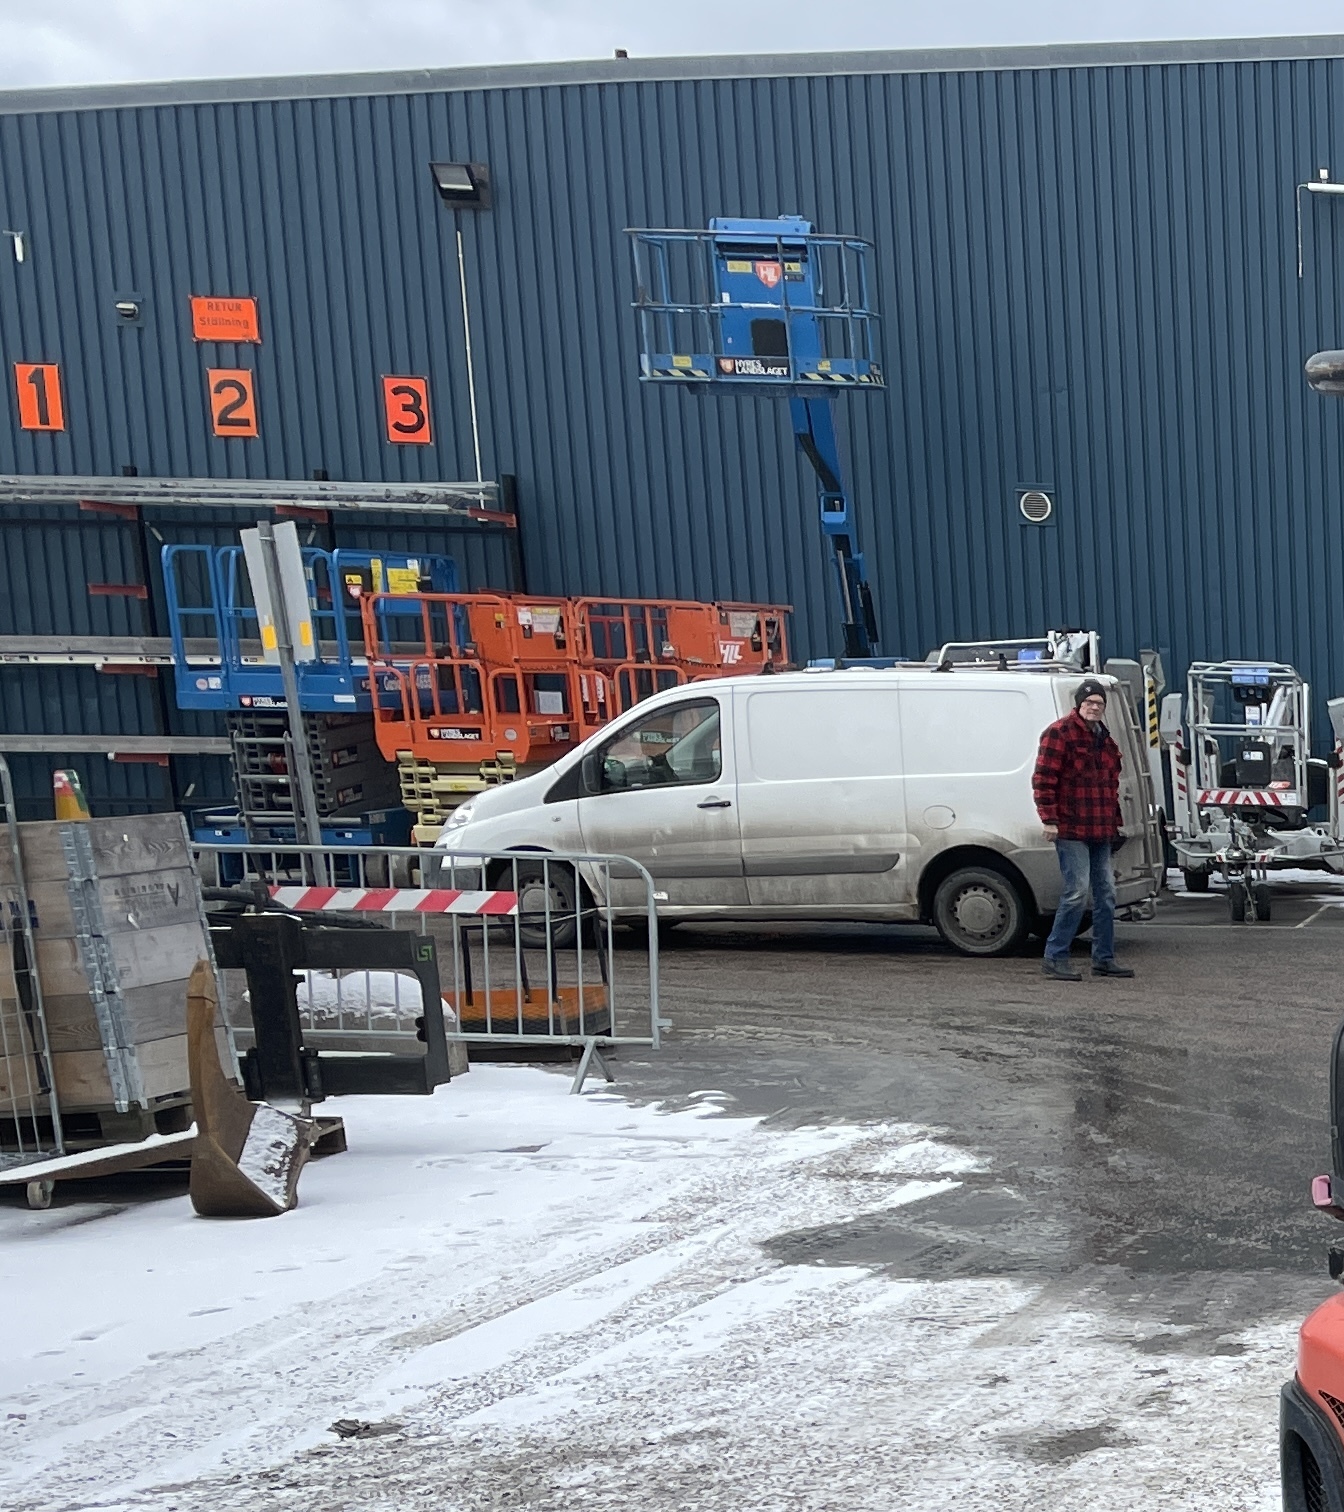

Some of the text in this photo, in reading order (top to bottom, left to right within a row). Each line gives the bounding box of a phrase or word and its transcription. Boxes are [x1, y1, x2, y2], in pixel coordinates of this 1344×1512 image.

[199, 316, 250, 330] Ställning
[206, 301, 243, 313] RETUR
[27, 367, 51, 427] 1
[213, 379, 251, 428] 2
[391, 385, 426, 435] 3
